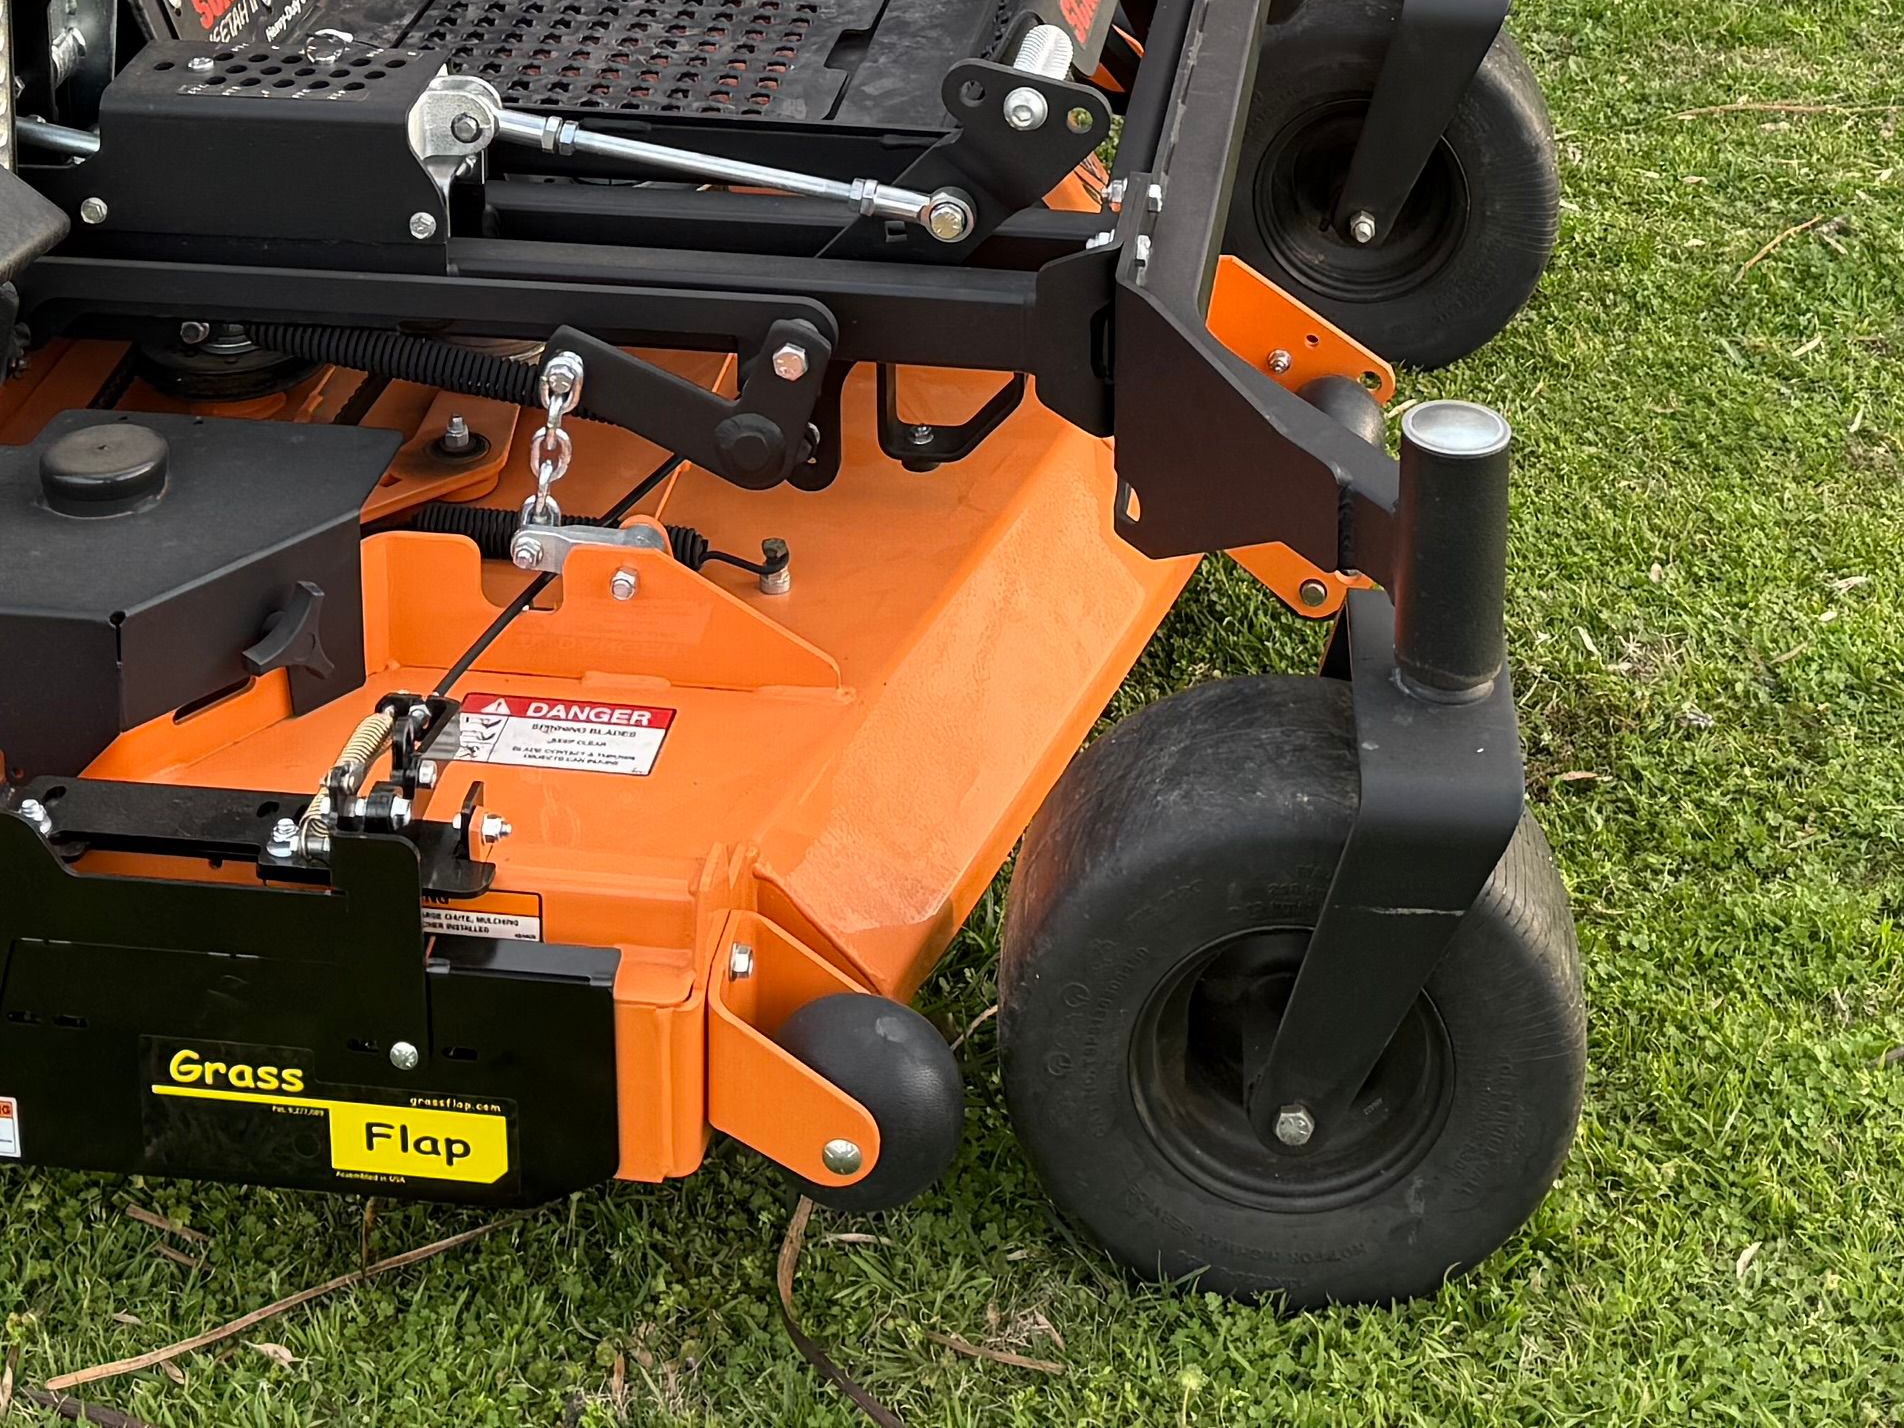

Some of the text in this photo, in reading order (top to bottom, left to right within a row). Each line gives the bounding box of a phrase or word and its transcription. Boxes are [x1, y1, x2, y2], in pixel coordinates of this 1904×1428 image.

[526, 702, 652, 727] DANGER
[446, 923, 490, 934] INSTALLED
[476, 916, 519, 927] MULCHING
[169, 1049, 305, 1092] Grass
[409, 1096, 502, 1113] grassflap.com
[365, 1121, 472, 1167] Flap
[389, 1174, 407, 1185] USA
